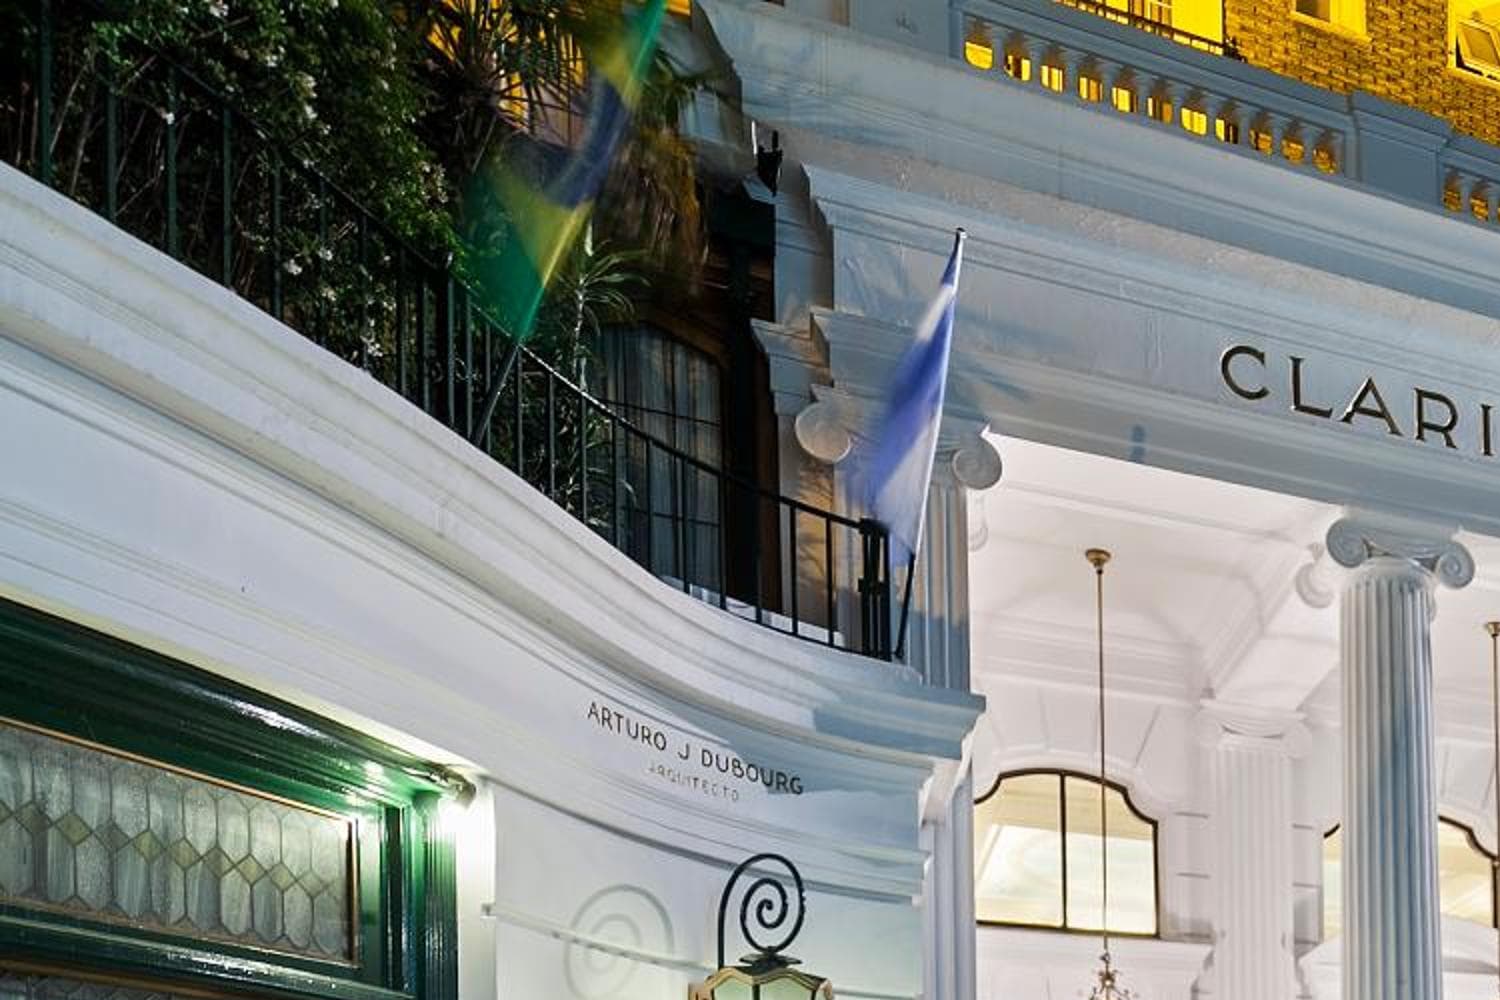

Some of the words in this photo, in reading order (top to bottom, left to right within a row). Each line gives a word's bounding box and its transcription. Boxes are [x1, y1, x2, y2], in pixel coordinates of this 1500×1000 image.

[587, 701, 667, 751] ARTURO
[677, 743, 690, 760] J
[701, 749, 804, 795] DUBOURG
